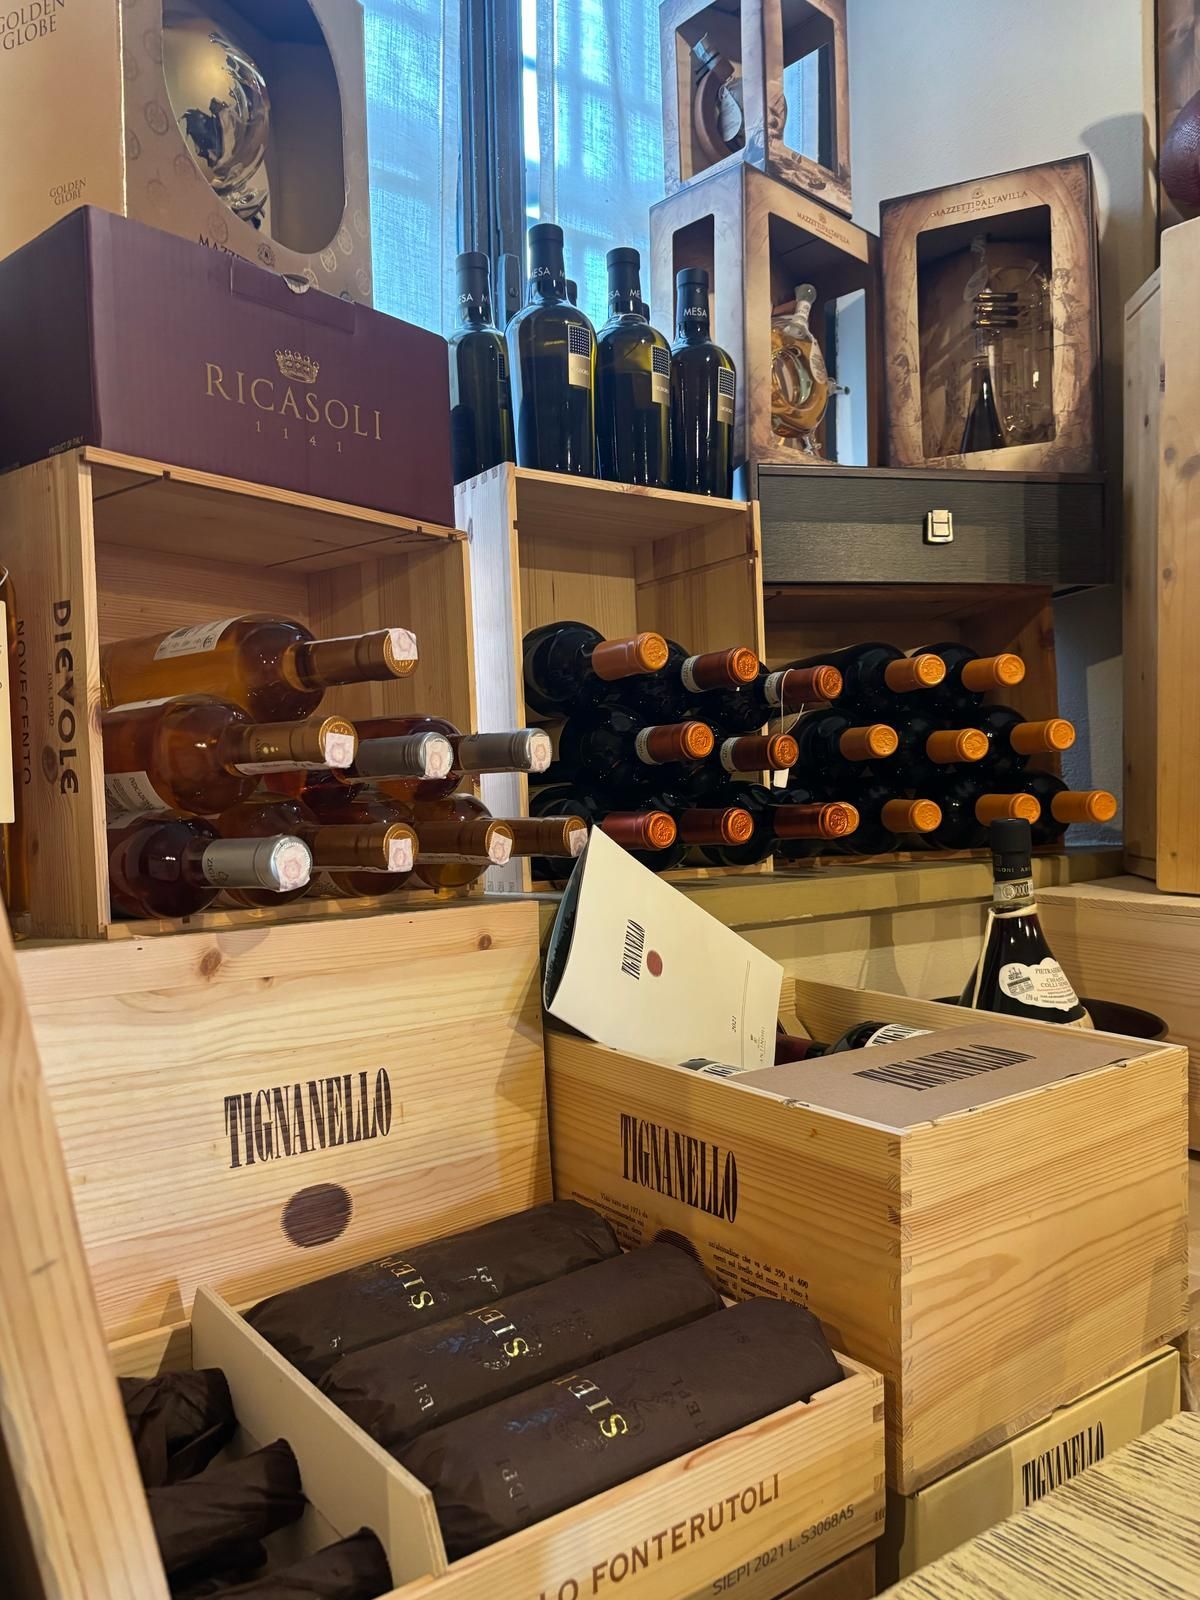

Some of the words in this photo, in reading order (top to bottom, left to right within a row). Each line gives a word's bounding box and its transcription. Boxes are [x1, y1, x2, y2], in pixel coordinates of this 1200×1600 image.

[3, 14, 57, 50] GLOBE
[49, 177, 87, 198] GOLDEN
[54, 188, 82, 206] GLOBE
[684, 307, 708, 318] MESA
[205, 362, 382, 440] RICASOLI
[53, 600, 79, 794] DIEVOLE
[621, 919, 645, 980] TIGNANELLO
[852, 1044, 1037, 1091] TIGNANELLO
[224, 1067, 392, 1168] TIGNANELLO
[620, 1113, 738, 1224] TIGNANELLO
[1022, 1421, 1104, 1508] TIGNANELLO
[592, 1473, 780, 1595] FONTERUTOLI
[712, 1564, 750, 1596] SIEPI
[754, 1543, 785, 1572] 2021
